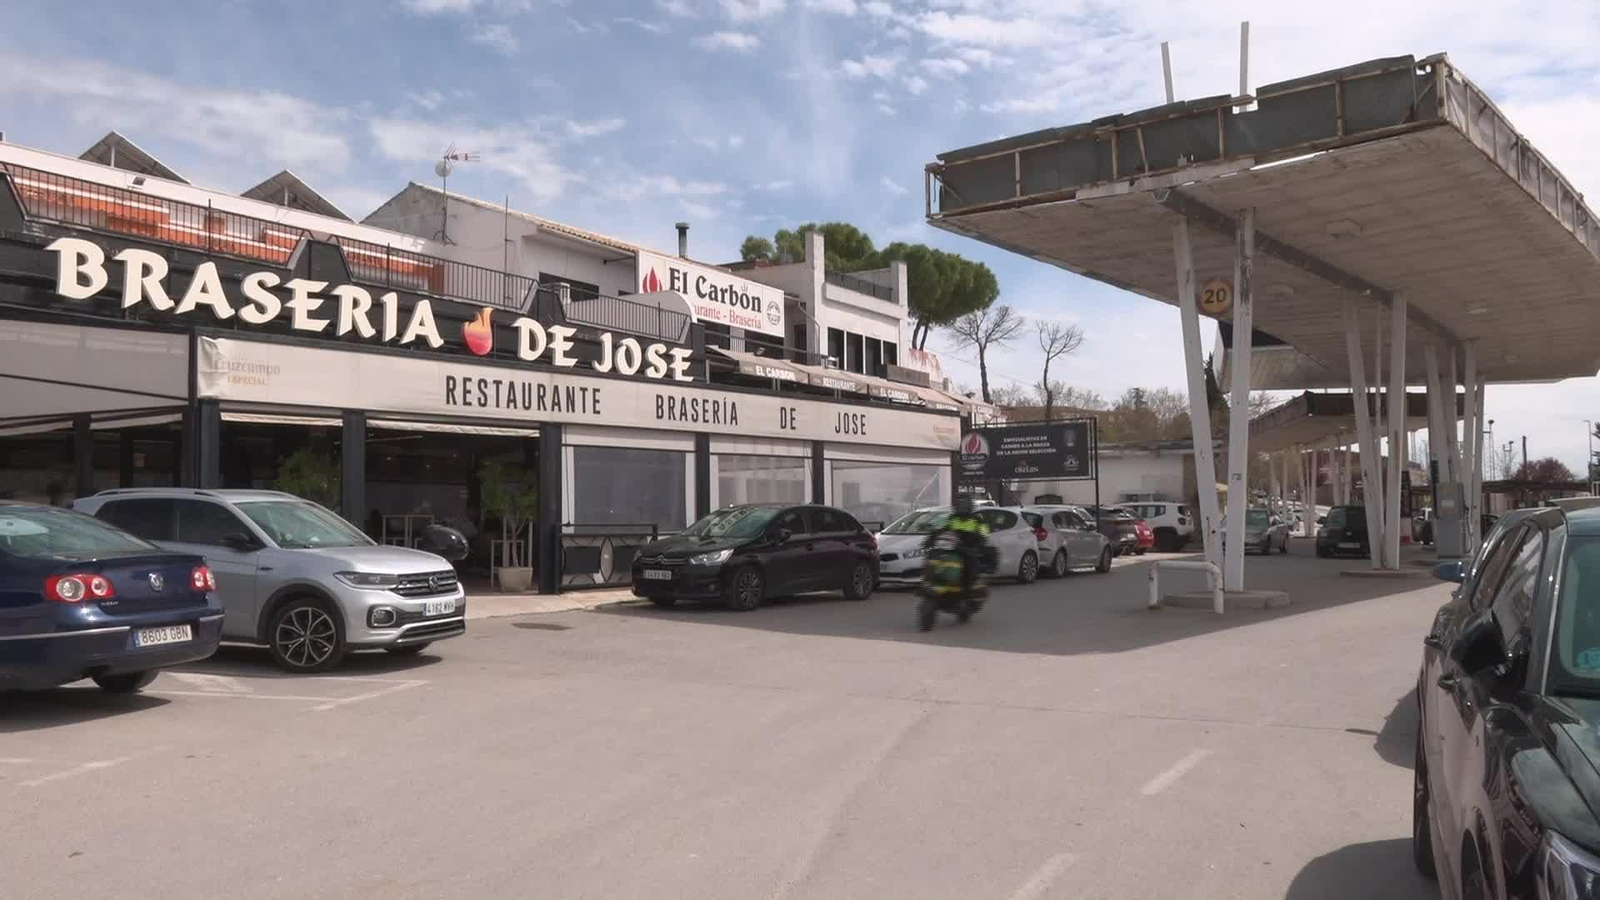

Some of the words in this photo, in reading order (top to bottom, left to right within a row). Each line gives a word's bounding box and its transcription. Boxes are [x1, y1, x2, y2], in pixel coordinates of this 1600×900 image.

[669, 267, 688, 295] El
[1204, 288, 1227, 304] 20
[44, 237, 445, 349] BRASERIA
[510, 317, 578, 367] DE
[592, 331, 694, 382] JOSE
[694, 304, 721, 320] urante
[755, 365, 765, 376] EL
[822, 376, 856, 392] RESTAURANTE
[880, 387, 887, 398] EL
[446, 375, 601, 415] RESTAURANTE
[656, 393, 738, 426] BRASERÍA
[780, 406, 797, 430] DE
[835, 411, 867, 435] JOSE
[141, 628, 168, 643] 8603
[170, 626, 189, 640] GBN
